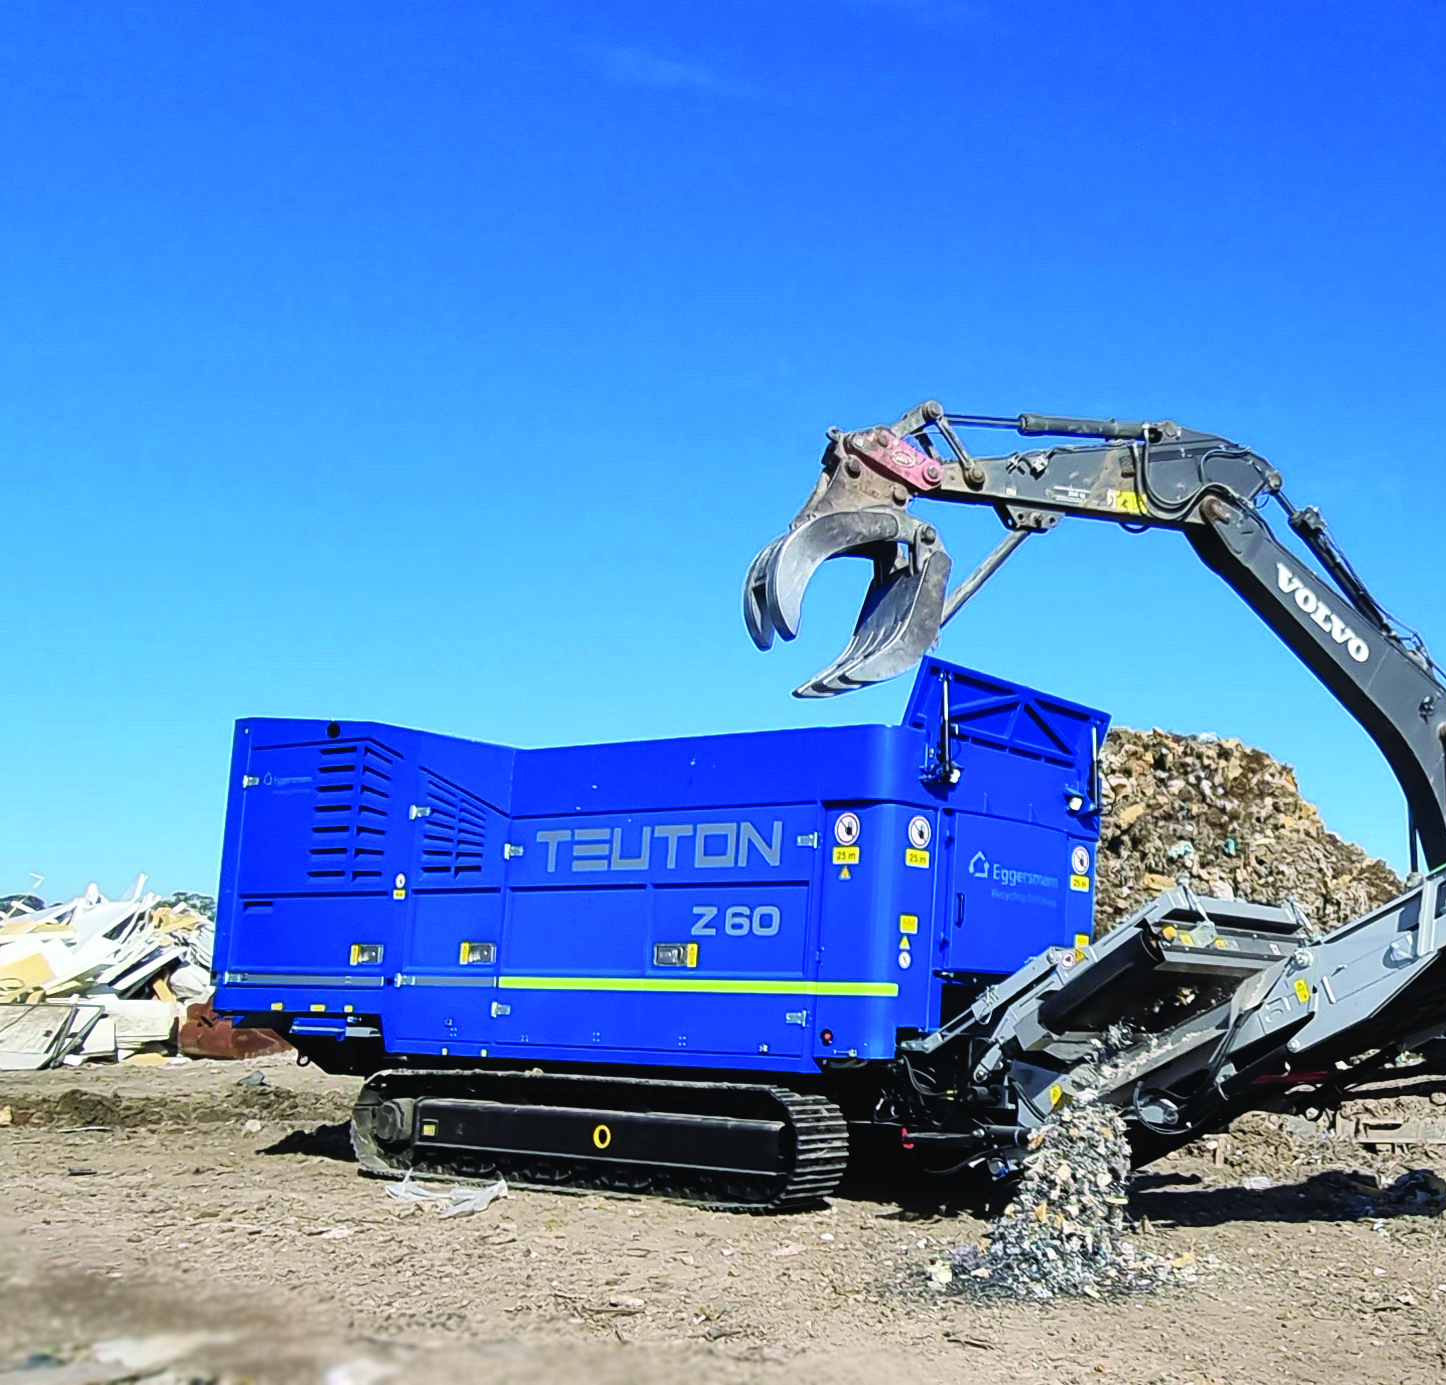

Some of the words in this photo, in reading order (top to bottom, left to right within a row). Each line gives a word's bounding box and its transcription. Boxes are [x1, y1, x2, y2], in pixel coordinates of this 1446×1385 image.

[1278, 565, 1368, 661] VOLVO
[536, 821, 782, 872] TEUTON
[836, 851, 846, 861] 25
[848, 852, 856, 860] m
[909, 853, 918, 863] 25
[992, 863, 1059, 888] Eggersmann
[691, 907, 718, 935] Z
[725, 906, 781, 935] 60
